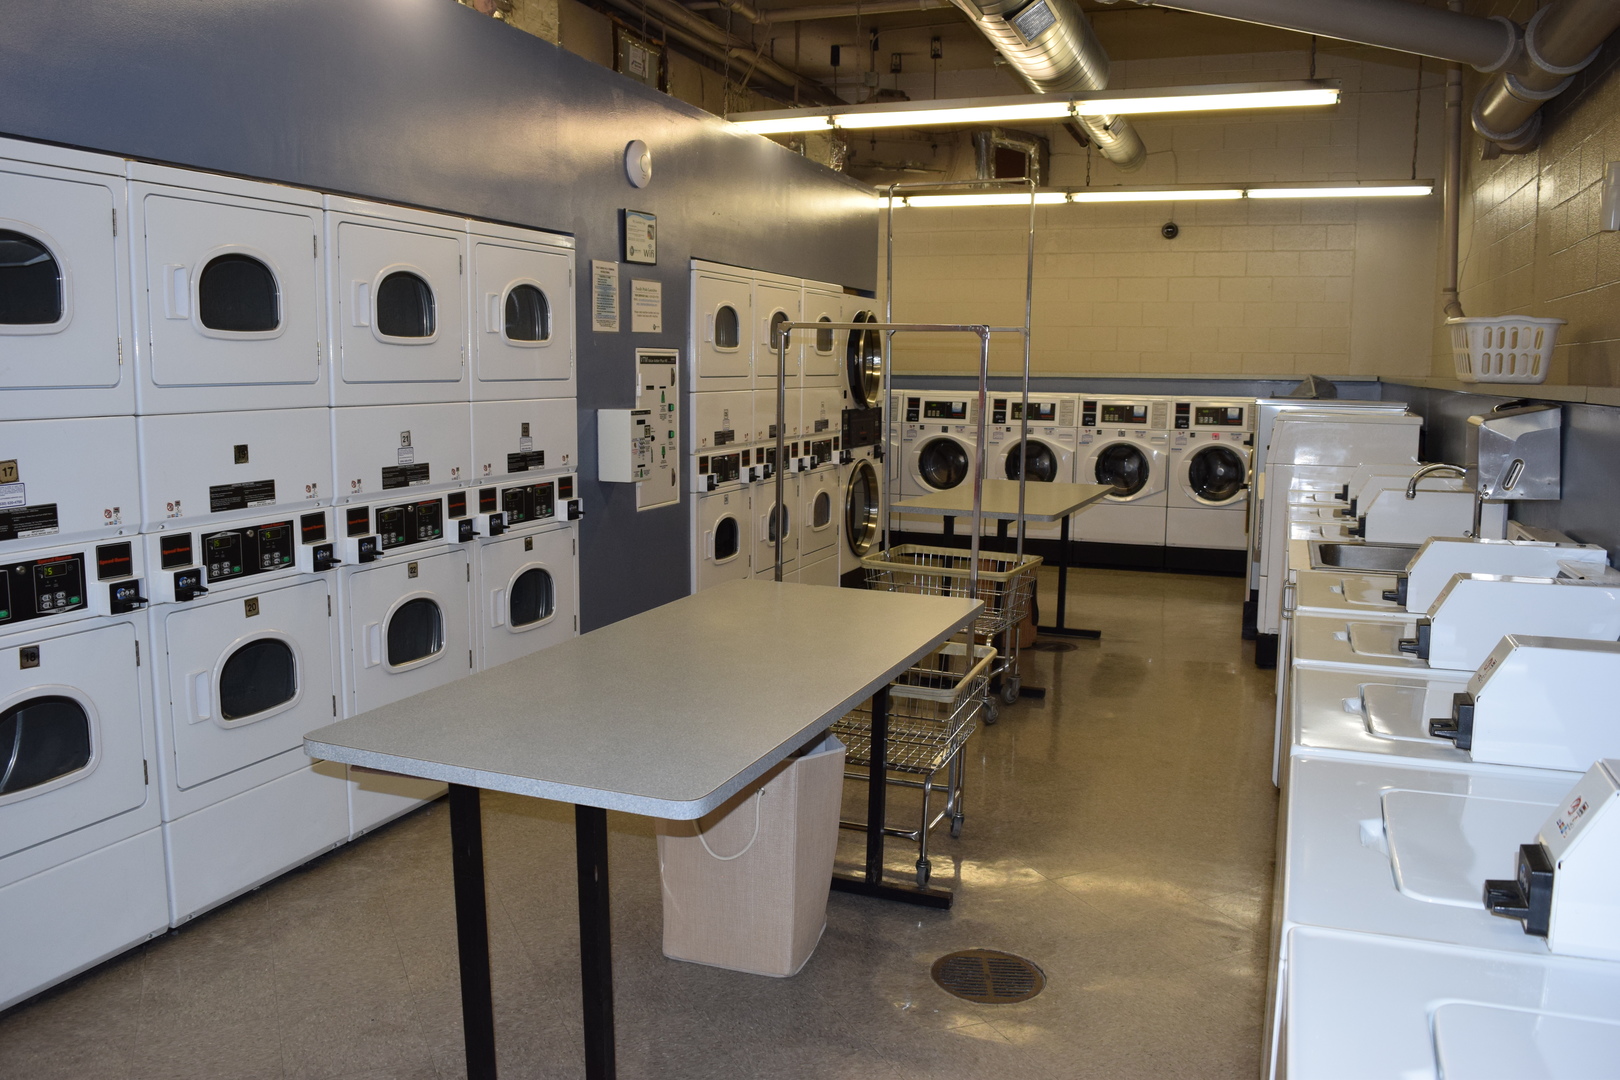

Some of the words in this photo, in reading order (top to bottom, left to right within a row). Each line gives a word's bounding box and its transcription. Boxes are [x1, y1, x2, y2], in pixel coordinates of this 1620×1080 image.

[402, 435, 409, 443] 21
[2, 466, 14, 478] 17
[410, 566, 417, 574] 22
[247, 602, 256, 612] 20
[24, 652, 36, 662] 18
